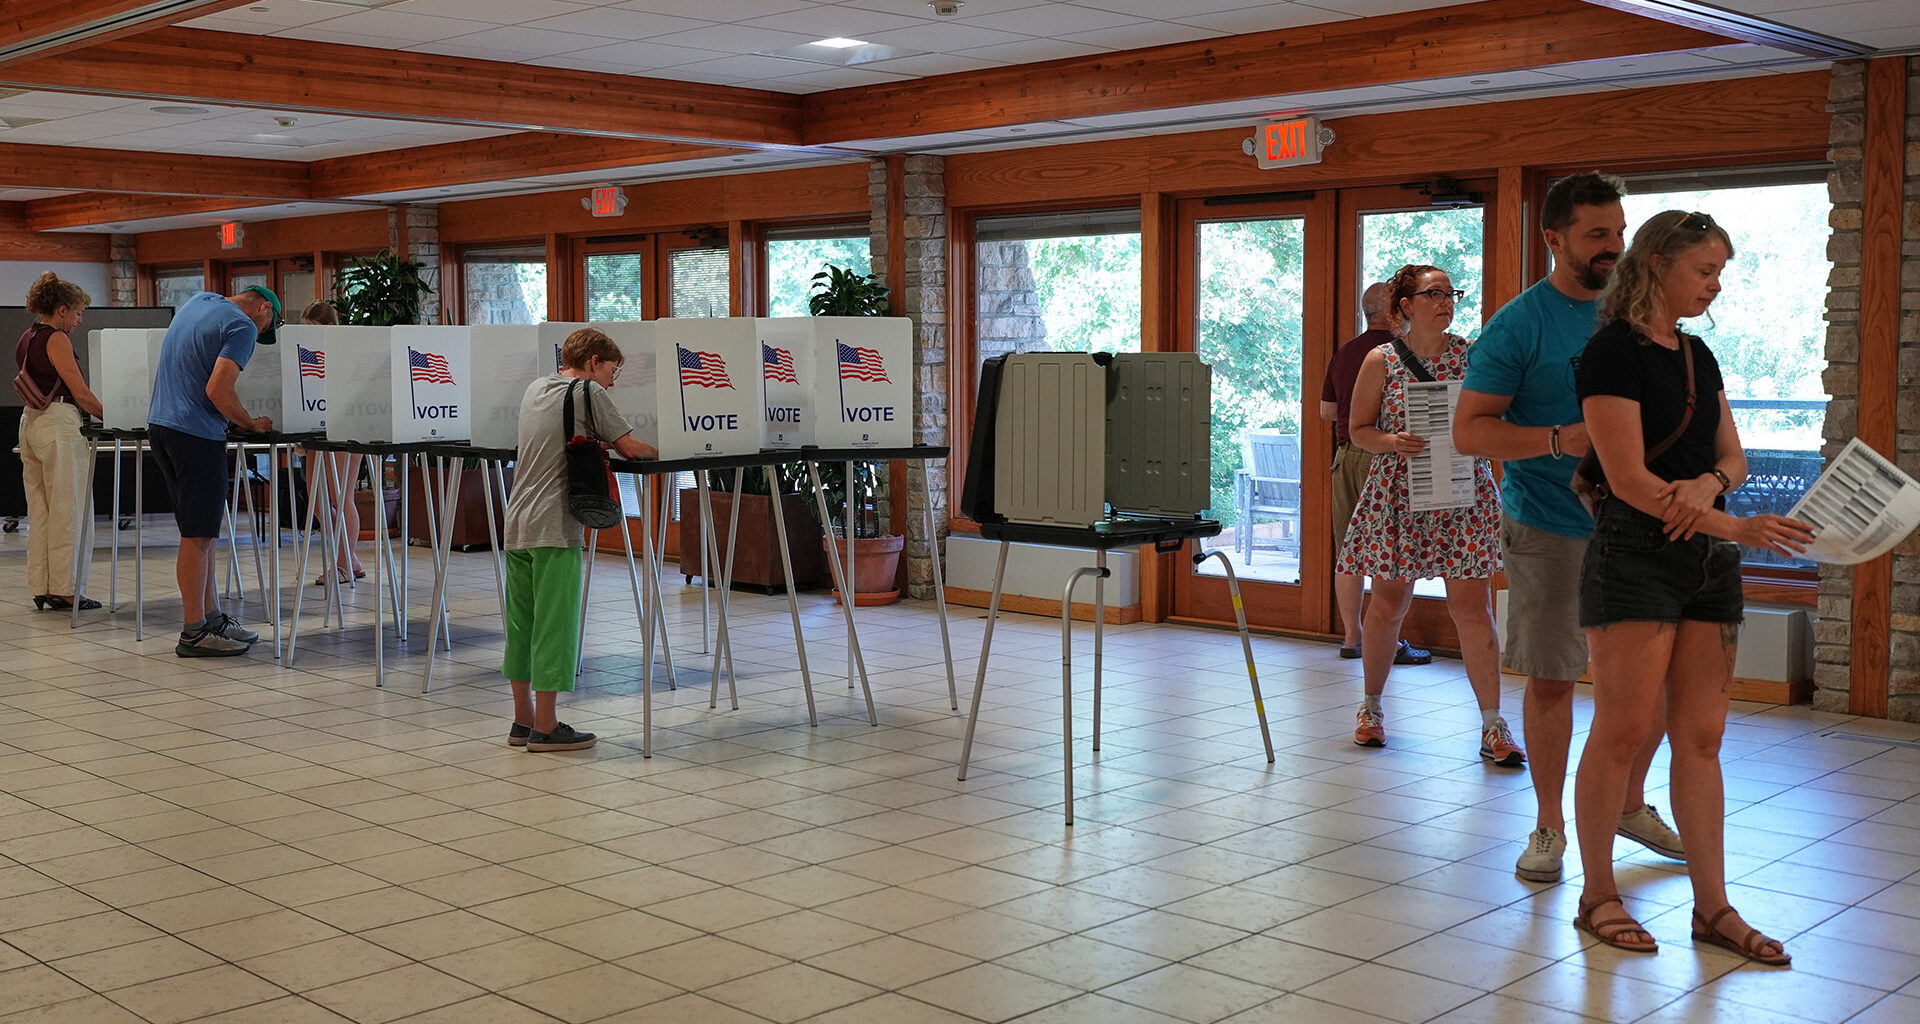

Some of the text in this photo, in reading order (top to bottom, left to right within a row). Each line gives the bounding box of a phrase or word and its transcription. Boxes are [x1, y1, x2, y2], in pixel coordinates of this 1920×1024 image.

[1265, 120, 1307, 160] EXIT
[595, 188, 616, 214] EXIT
[222, 223, 235, 245] EXIT
[306, 399, 327, 412] VO
[417, 405, 458, 419] VOTE
[688, 414, 738, 431] VOTE
[768, 407, 801, 423] VOTE
[846, 406, 895, 423] VOTE
